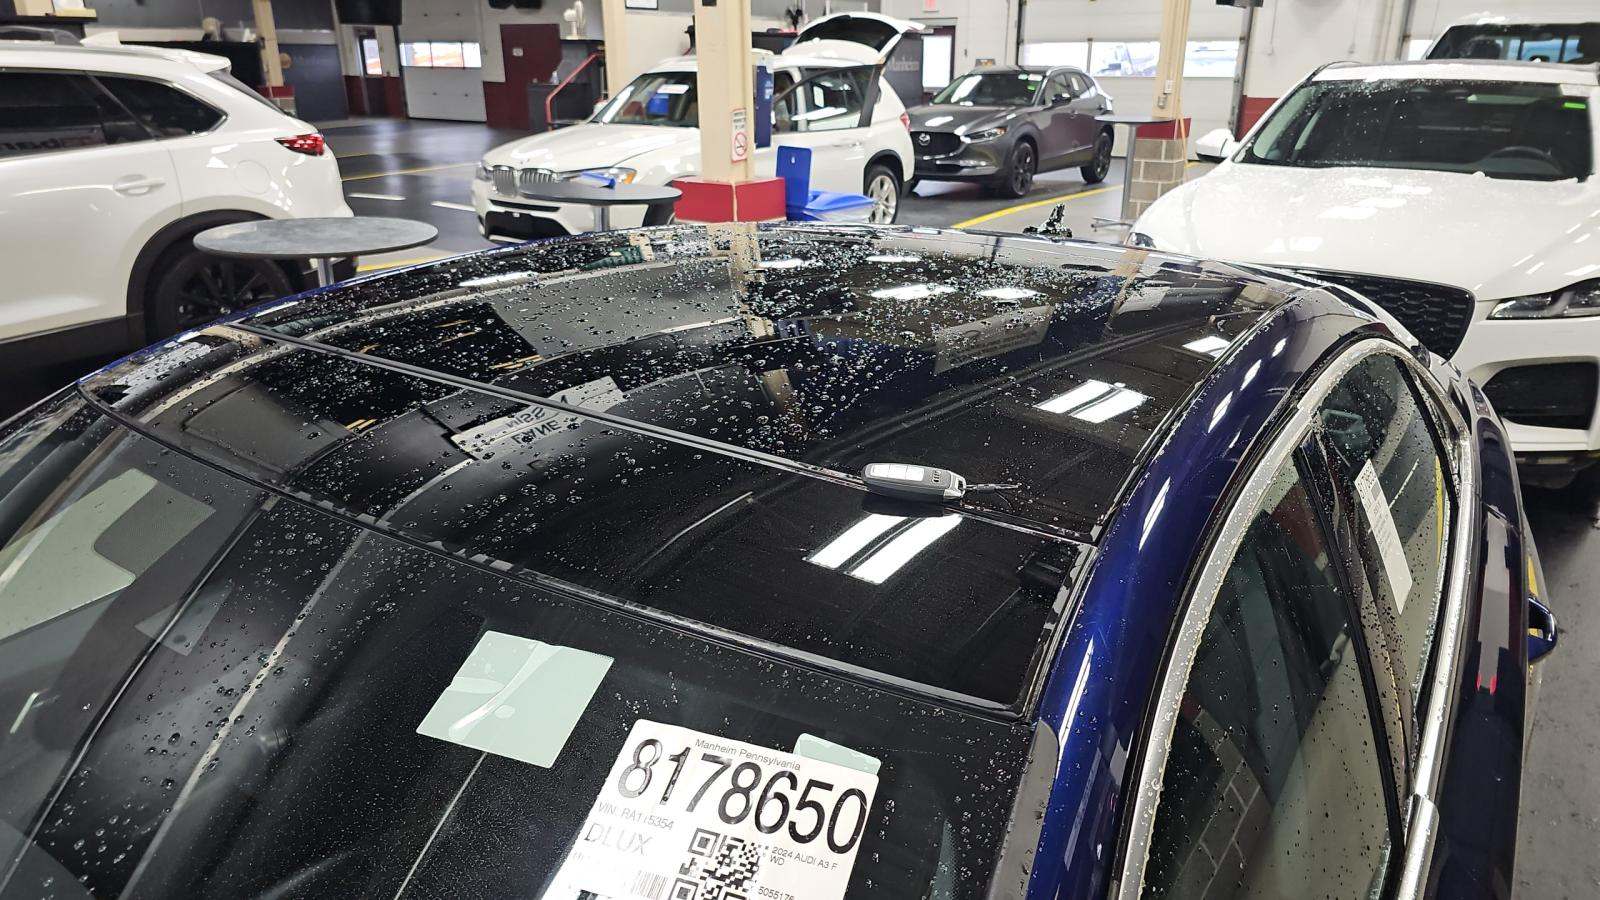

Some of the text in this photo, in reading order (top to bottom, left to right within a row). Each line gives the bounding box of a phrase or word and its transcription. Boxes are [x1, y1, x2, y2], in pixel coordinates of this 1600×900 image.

[694, 738, 801, 770] Manheim Pennsylvania
[617, 738, 868, 855] 8178650
[583, 822, 653, 856] DLUX
[770, 855, 785, 866] WD
[771, 846, 838, 871] 2024 AUDI A3 F
